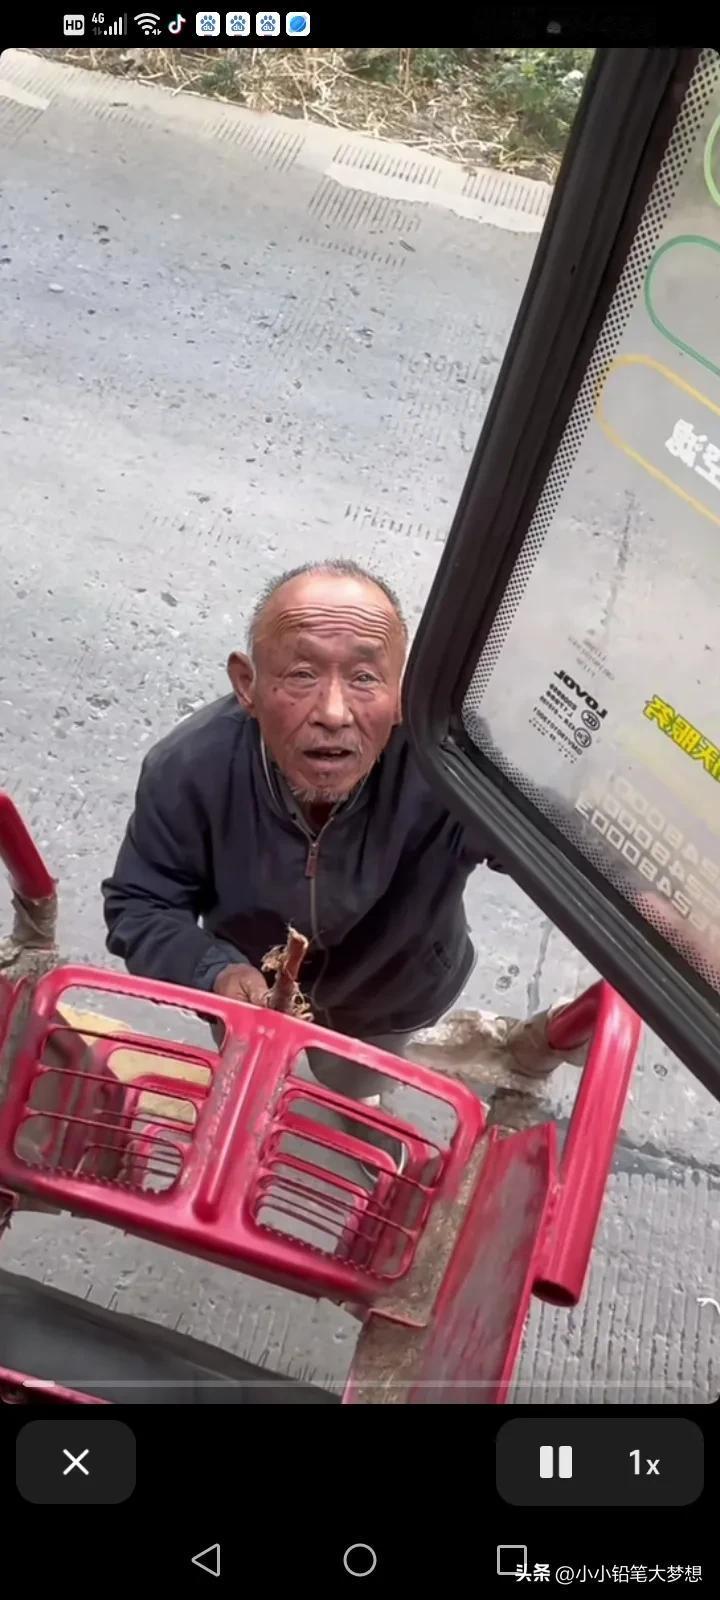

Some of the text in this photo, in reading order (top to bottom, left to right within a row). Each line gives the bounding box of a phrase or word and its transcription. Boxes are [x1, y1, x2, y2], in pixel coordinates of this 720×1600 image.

[91, 13, 105, 24] 4G
[65, 19, 84, 31] HD
[629, 1449, 661, 1475] 1x
